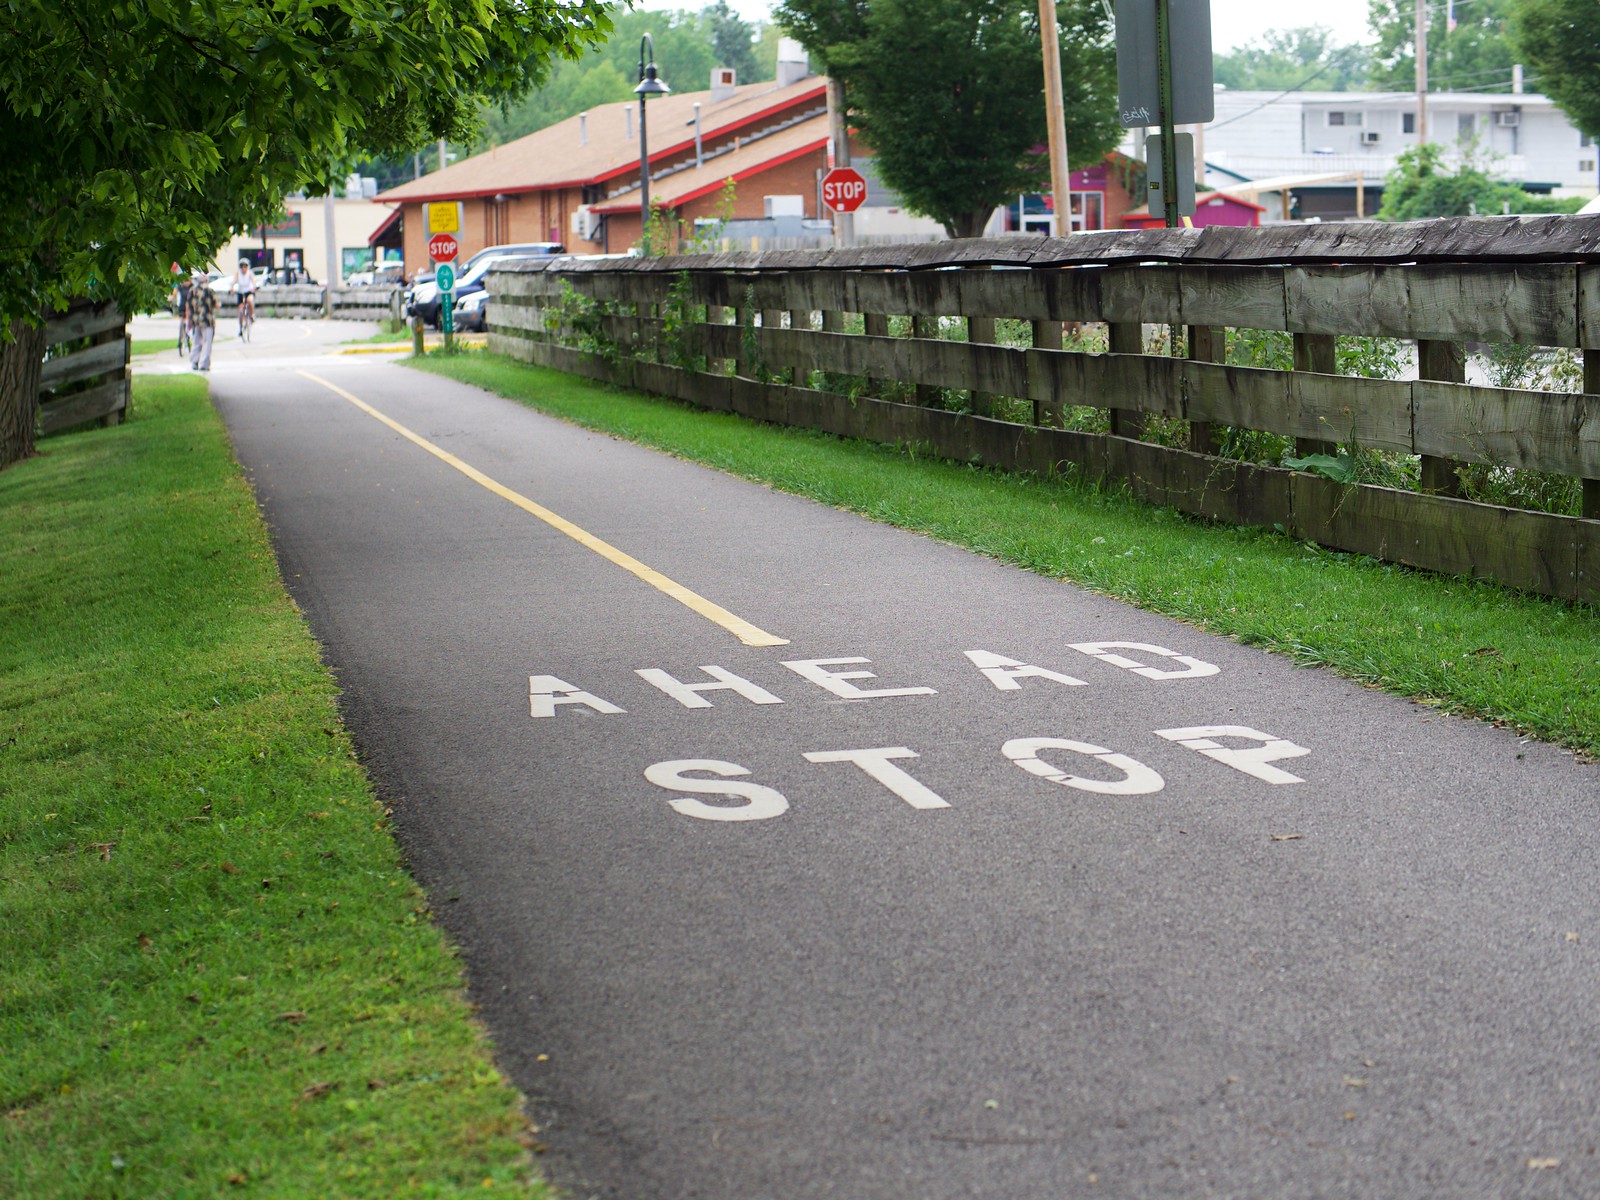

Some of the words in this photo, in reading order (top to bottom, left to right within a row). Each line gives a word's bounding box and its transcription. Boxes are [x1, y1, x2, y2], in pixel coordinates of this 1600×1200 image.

[824, 181, 864, 200] STOP
[430, 241, 457, 255] STOP
[529, 641, 1221, 718] AHEAD
[644, 725, 1312, 821] STOP
